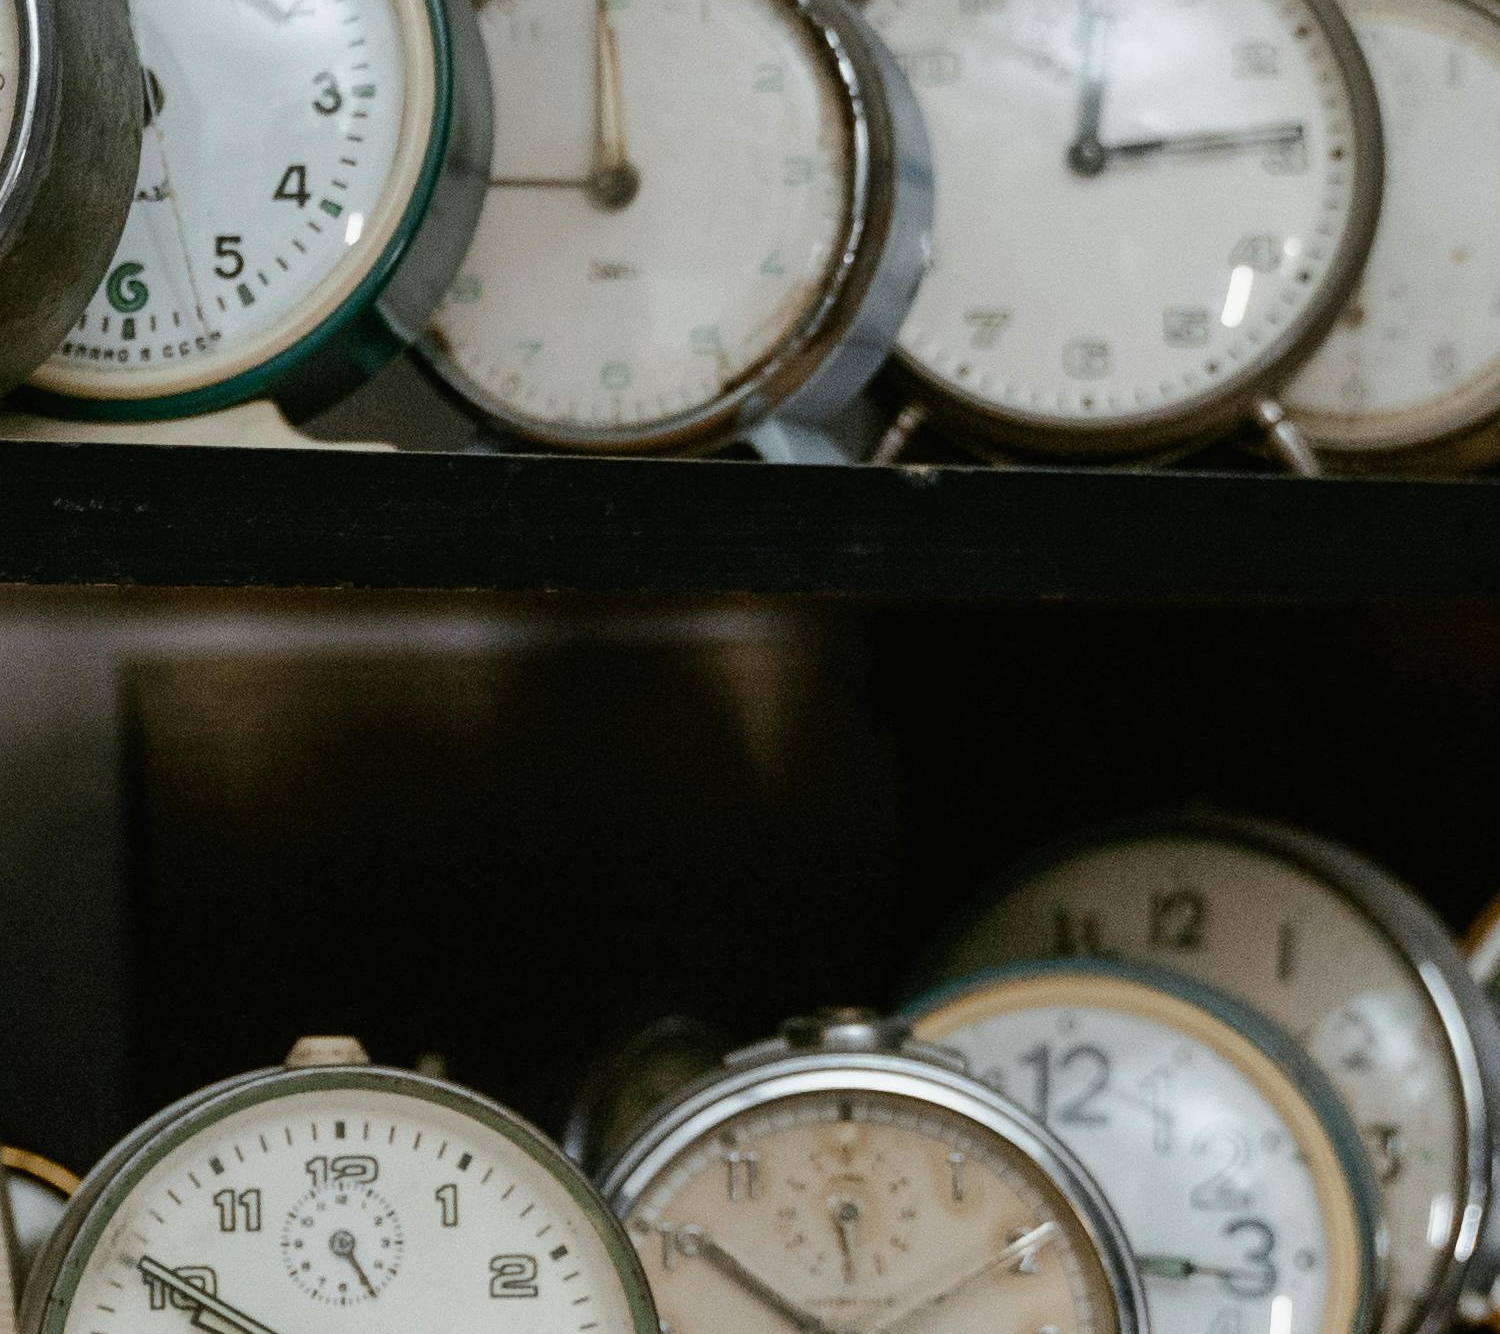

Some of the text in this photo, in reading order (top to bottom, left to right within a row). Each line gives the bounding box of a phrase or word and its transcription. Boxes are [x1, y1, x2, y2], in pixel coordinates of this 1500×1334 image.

[311, 71, 342, 116] 3
[272, 164, 311, 208] 4
[213, 235, 245, 280] 5
[106, 262, 149, 312] 6
[1019, 1043, 1110, 1125] 12
[213, 1189, 263, 1233] 11
[435, 1184, 459, 1227] 1
[489, 1254, 539, 1298] 2
[1220, 1217, 1276, 1299] 3
